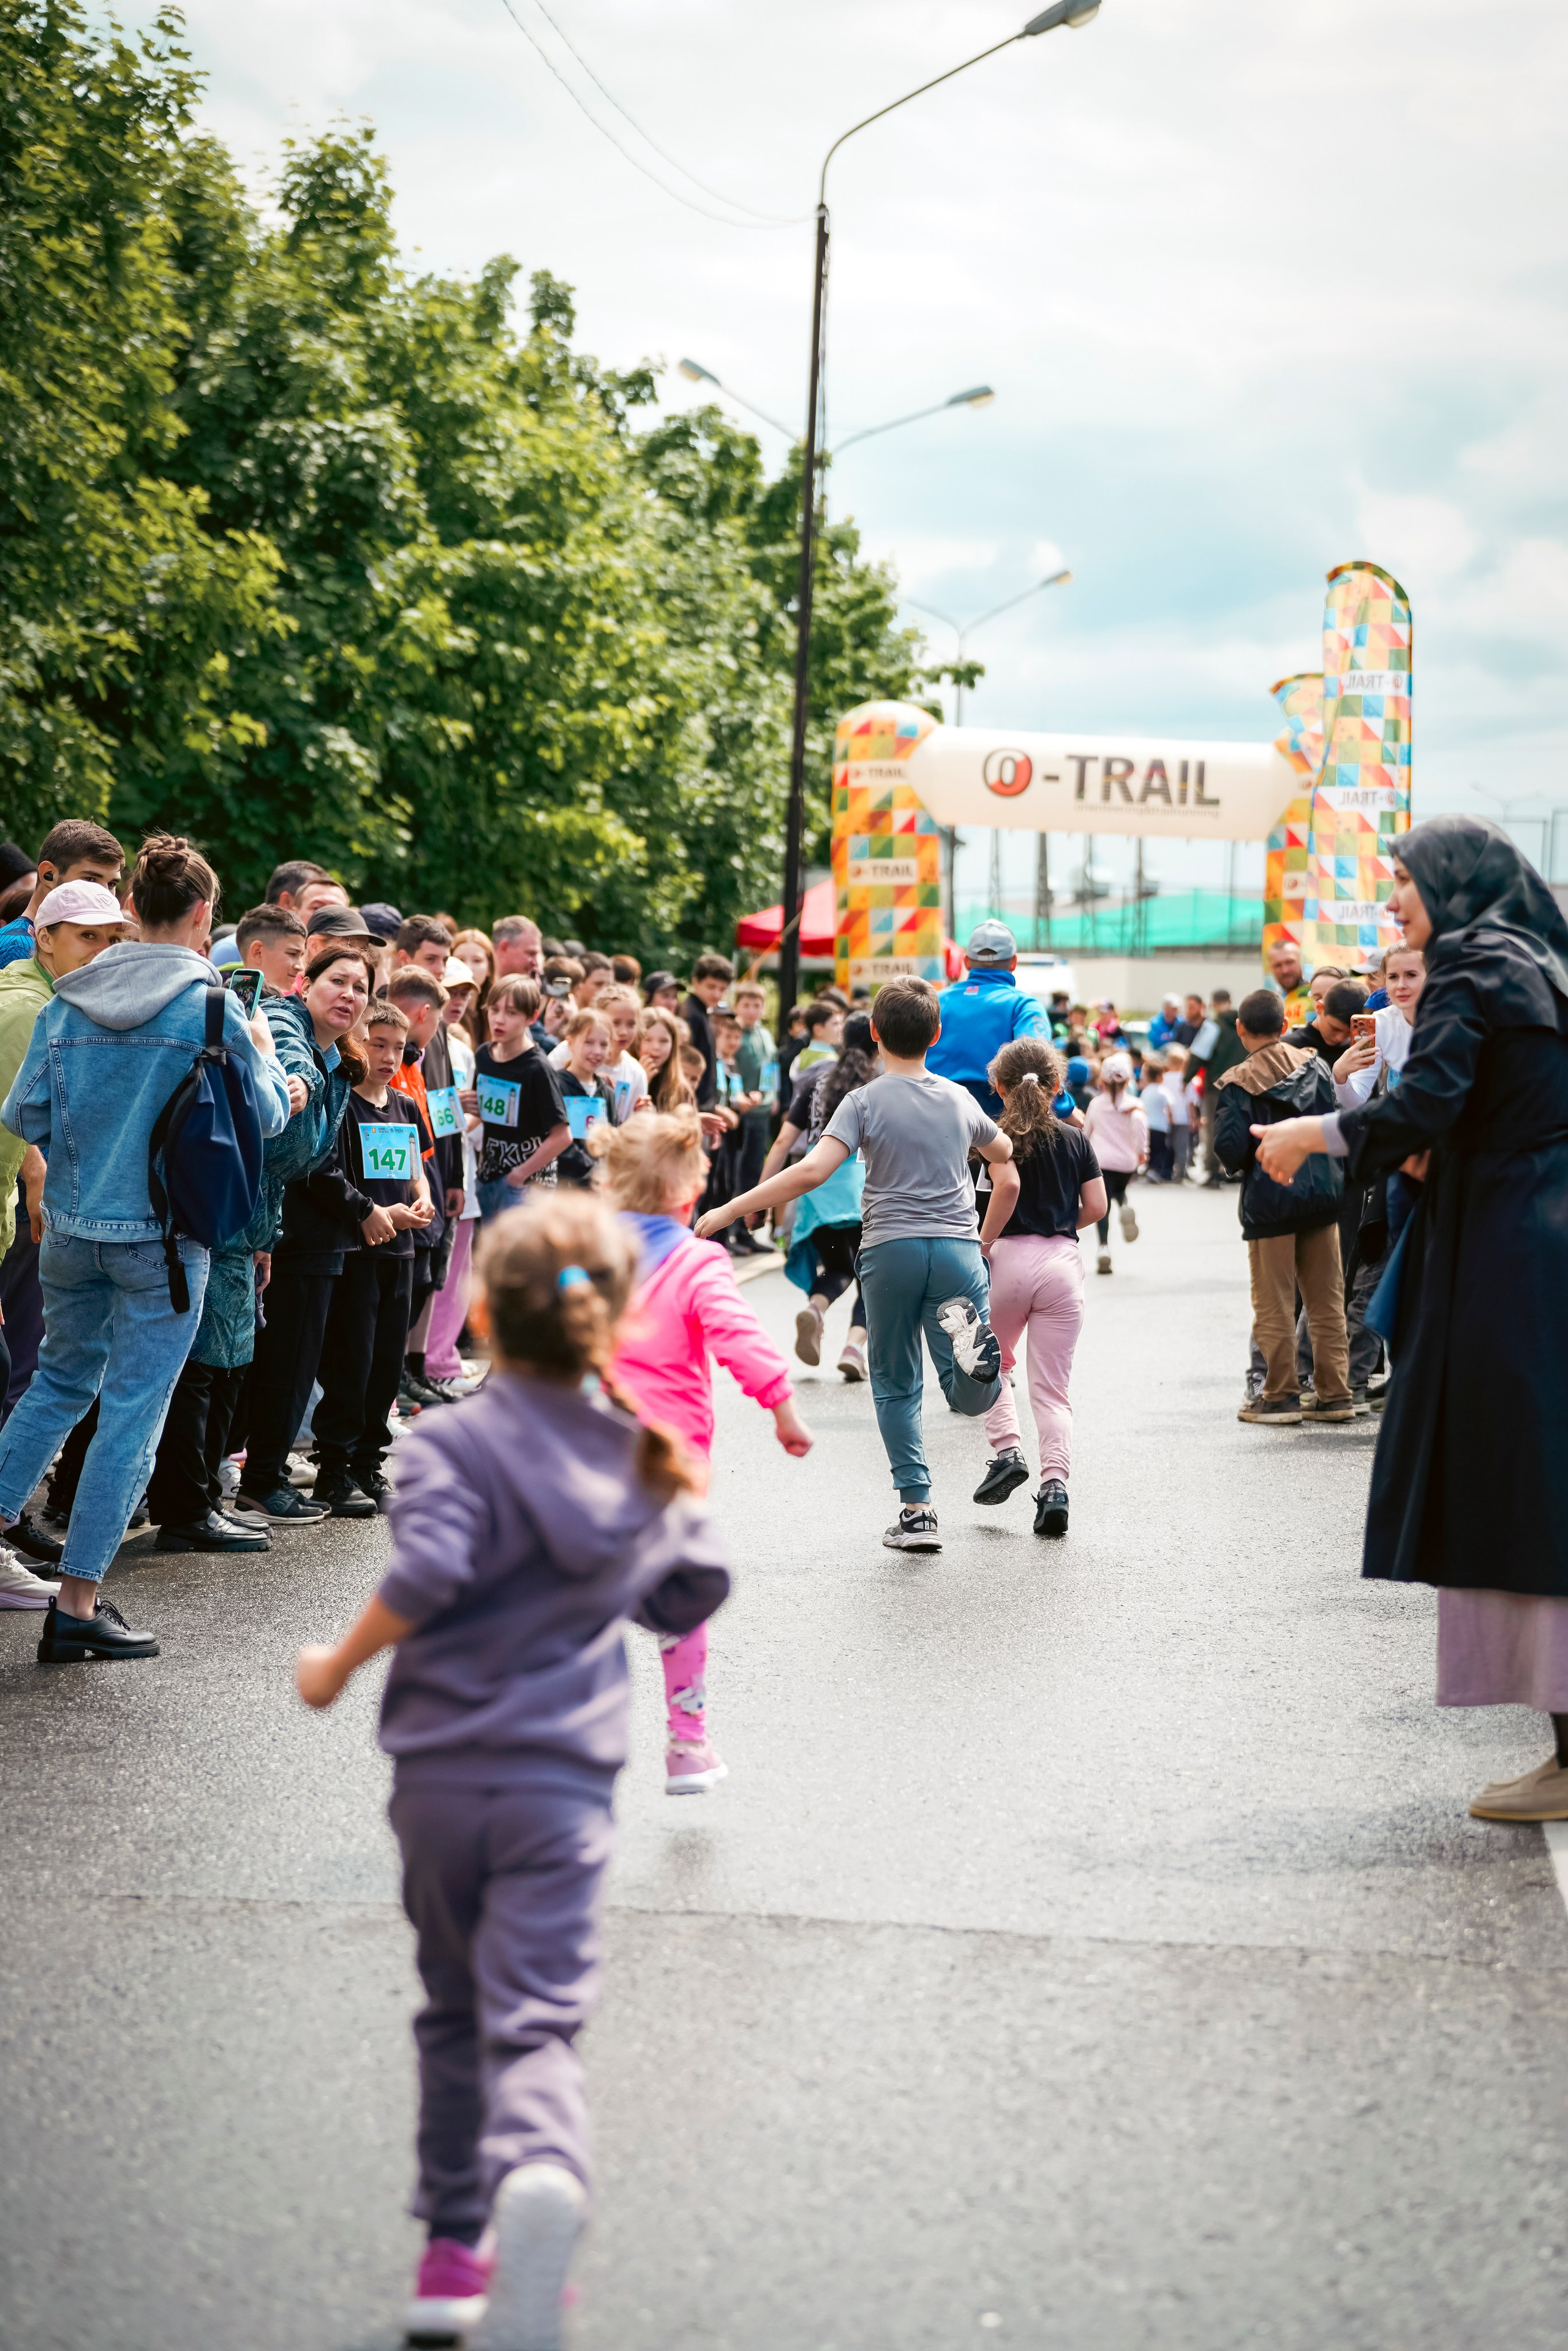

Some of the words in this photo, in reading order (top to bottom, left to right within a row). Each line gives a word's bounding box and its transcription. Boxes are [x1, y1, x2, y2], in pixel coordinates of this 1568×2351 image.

[478, 1094, 505, 1116] 148
[433, 1108, 454, 1126] 66
[368, 1149, 407, 1171] 147
